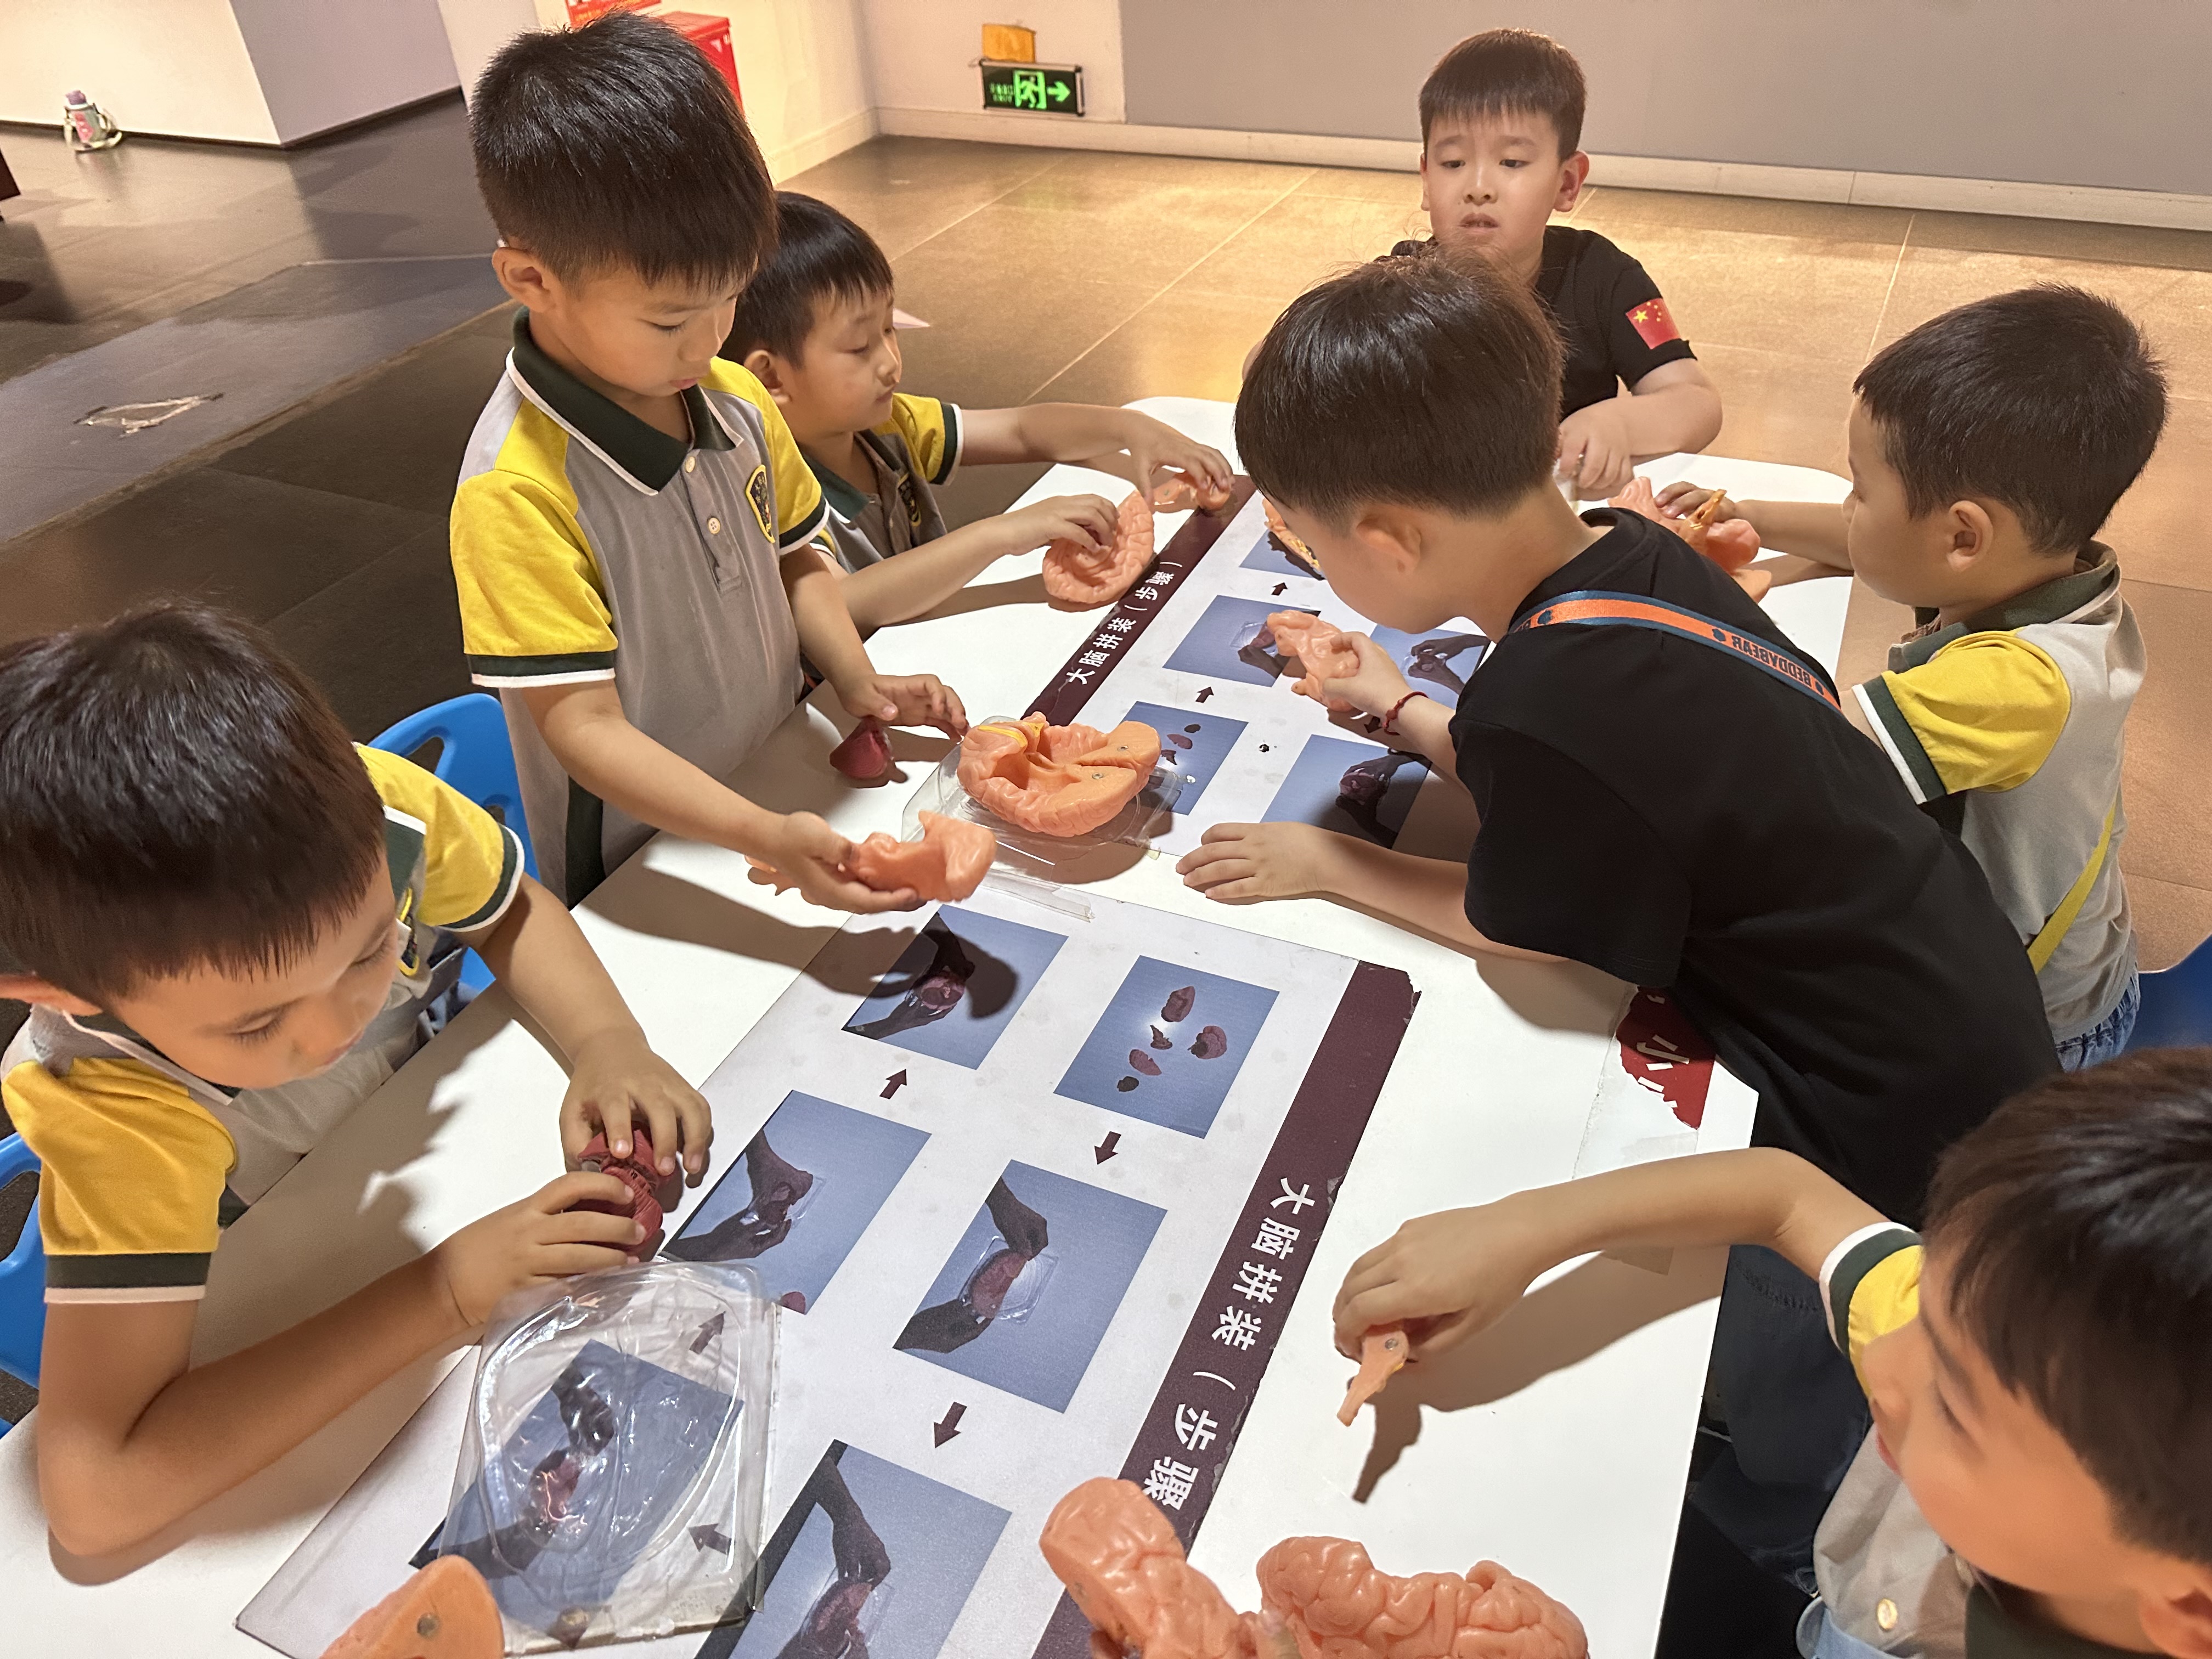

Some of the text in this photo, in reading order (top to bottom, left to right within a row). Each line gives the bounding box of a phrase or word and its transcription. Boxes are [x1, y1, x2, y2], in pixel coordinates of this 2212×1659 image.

[1066, 562, 1183, 685] 大脑拼装（步骤）
[1142, 1177, 1316, 1510] 大脑拼装（步骤
